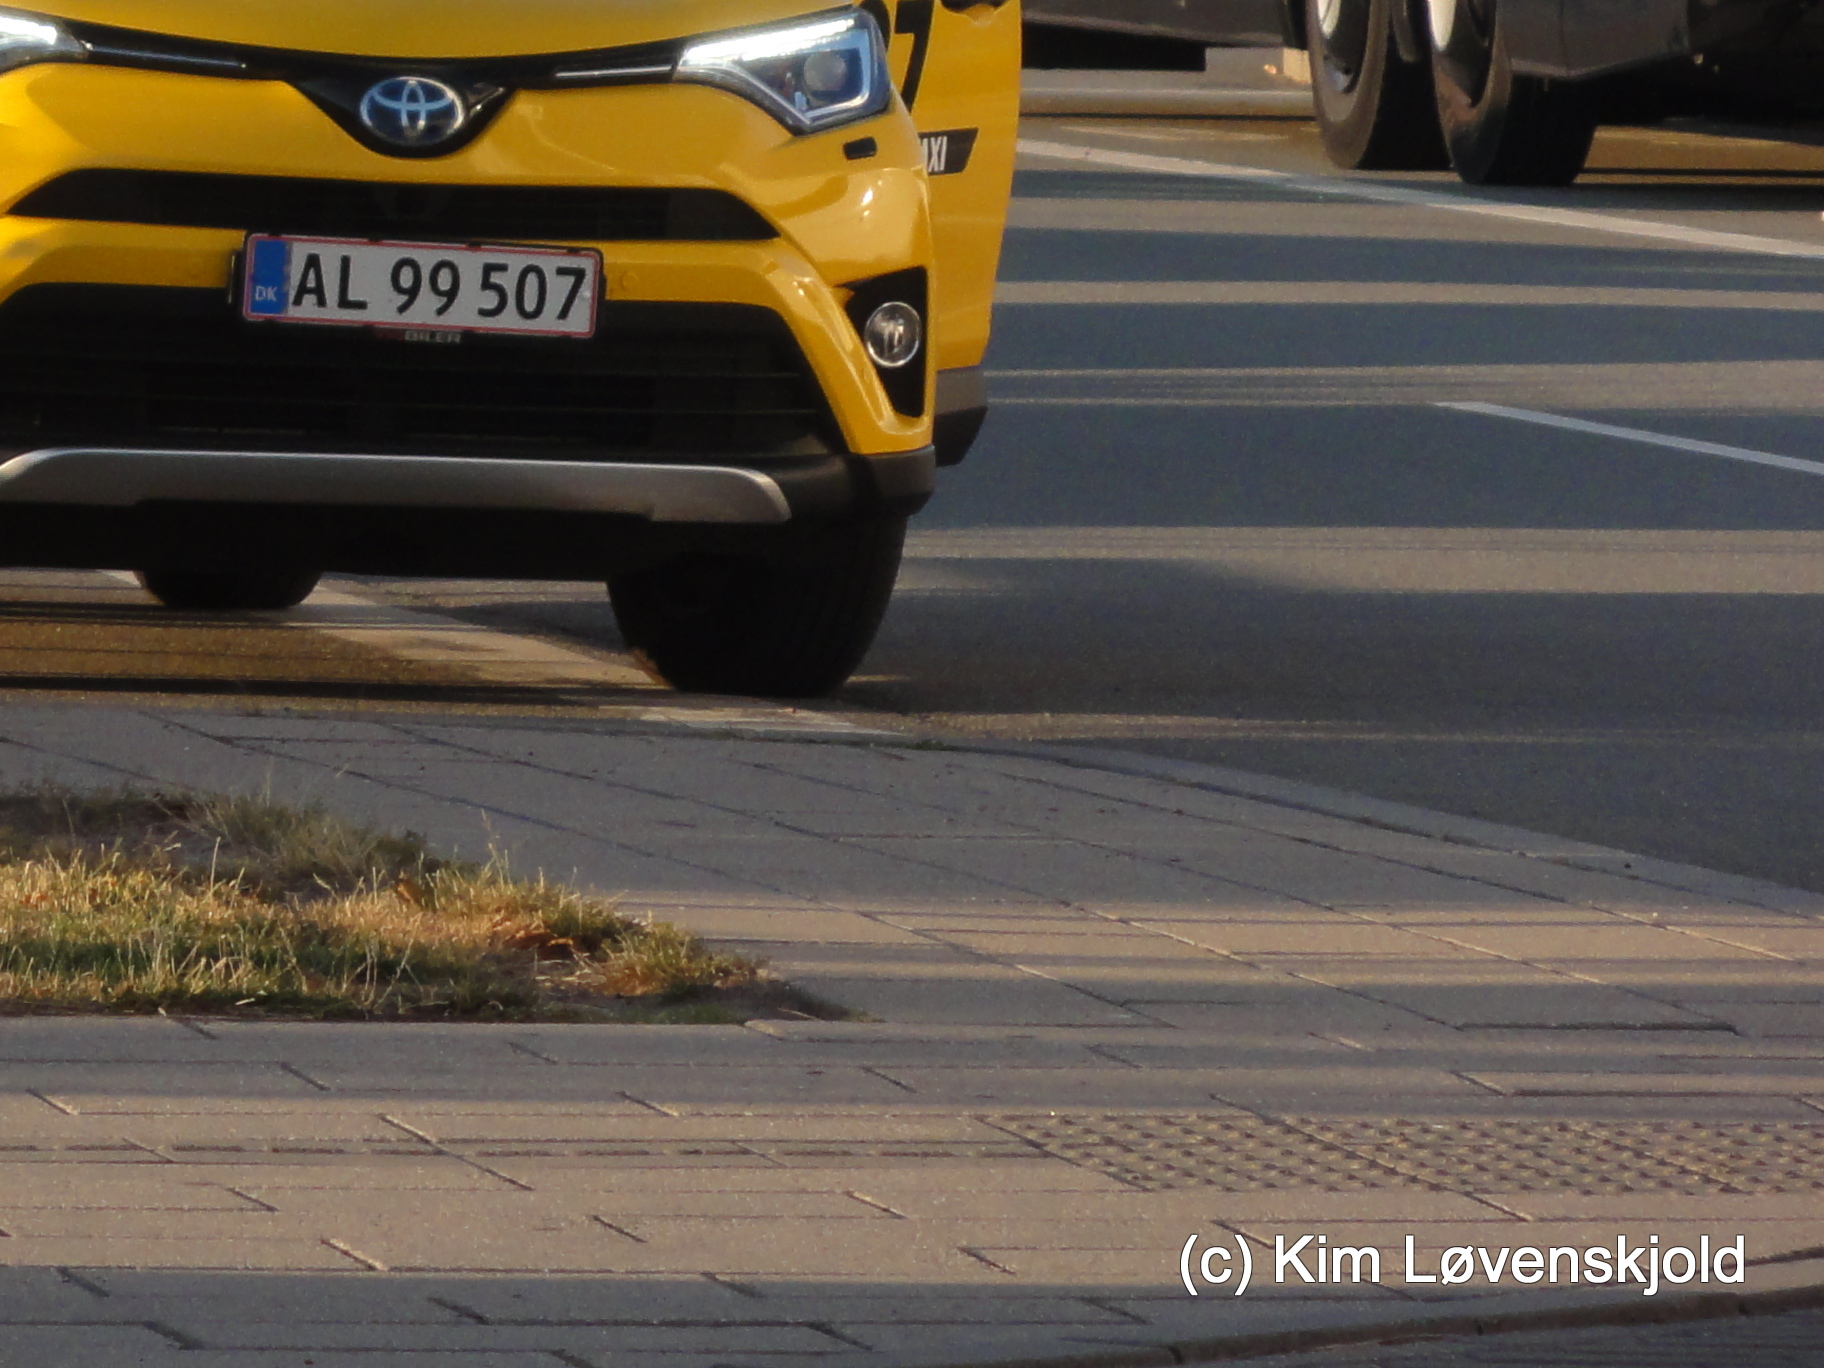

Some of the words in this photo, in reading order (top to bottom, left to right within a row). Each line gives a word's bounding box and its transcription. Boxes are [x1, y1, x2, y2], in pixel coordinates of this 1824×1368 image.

[254, 285, 277, 302] DK
[292, 252, 368, 311] AL
[389, 256, 461, 317] 99
[477, 262, 587, 321] 507
